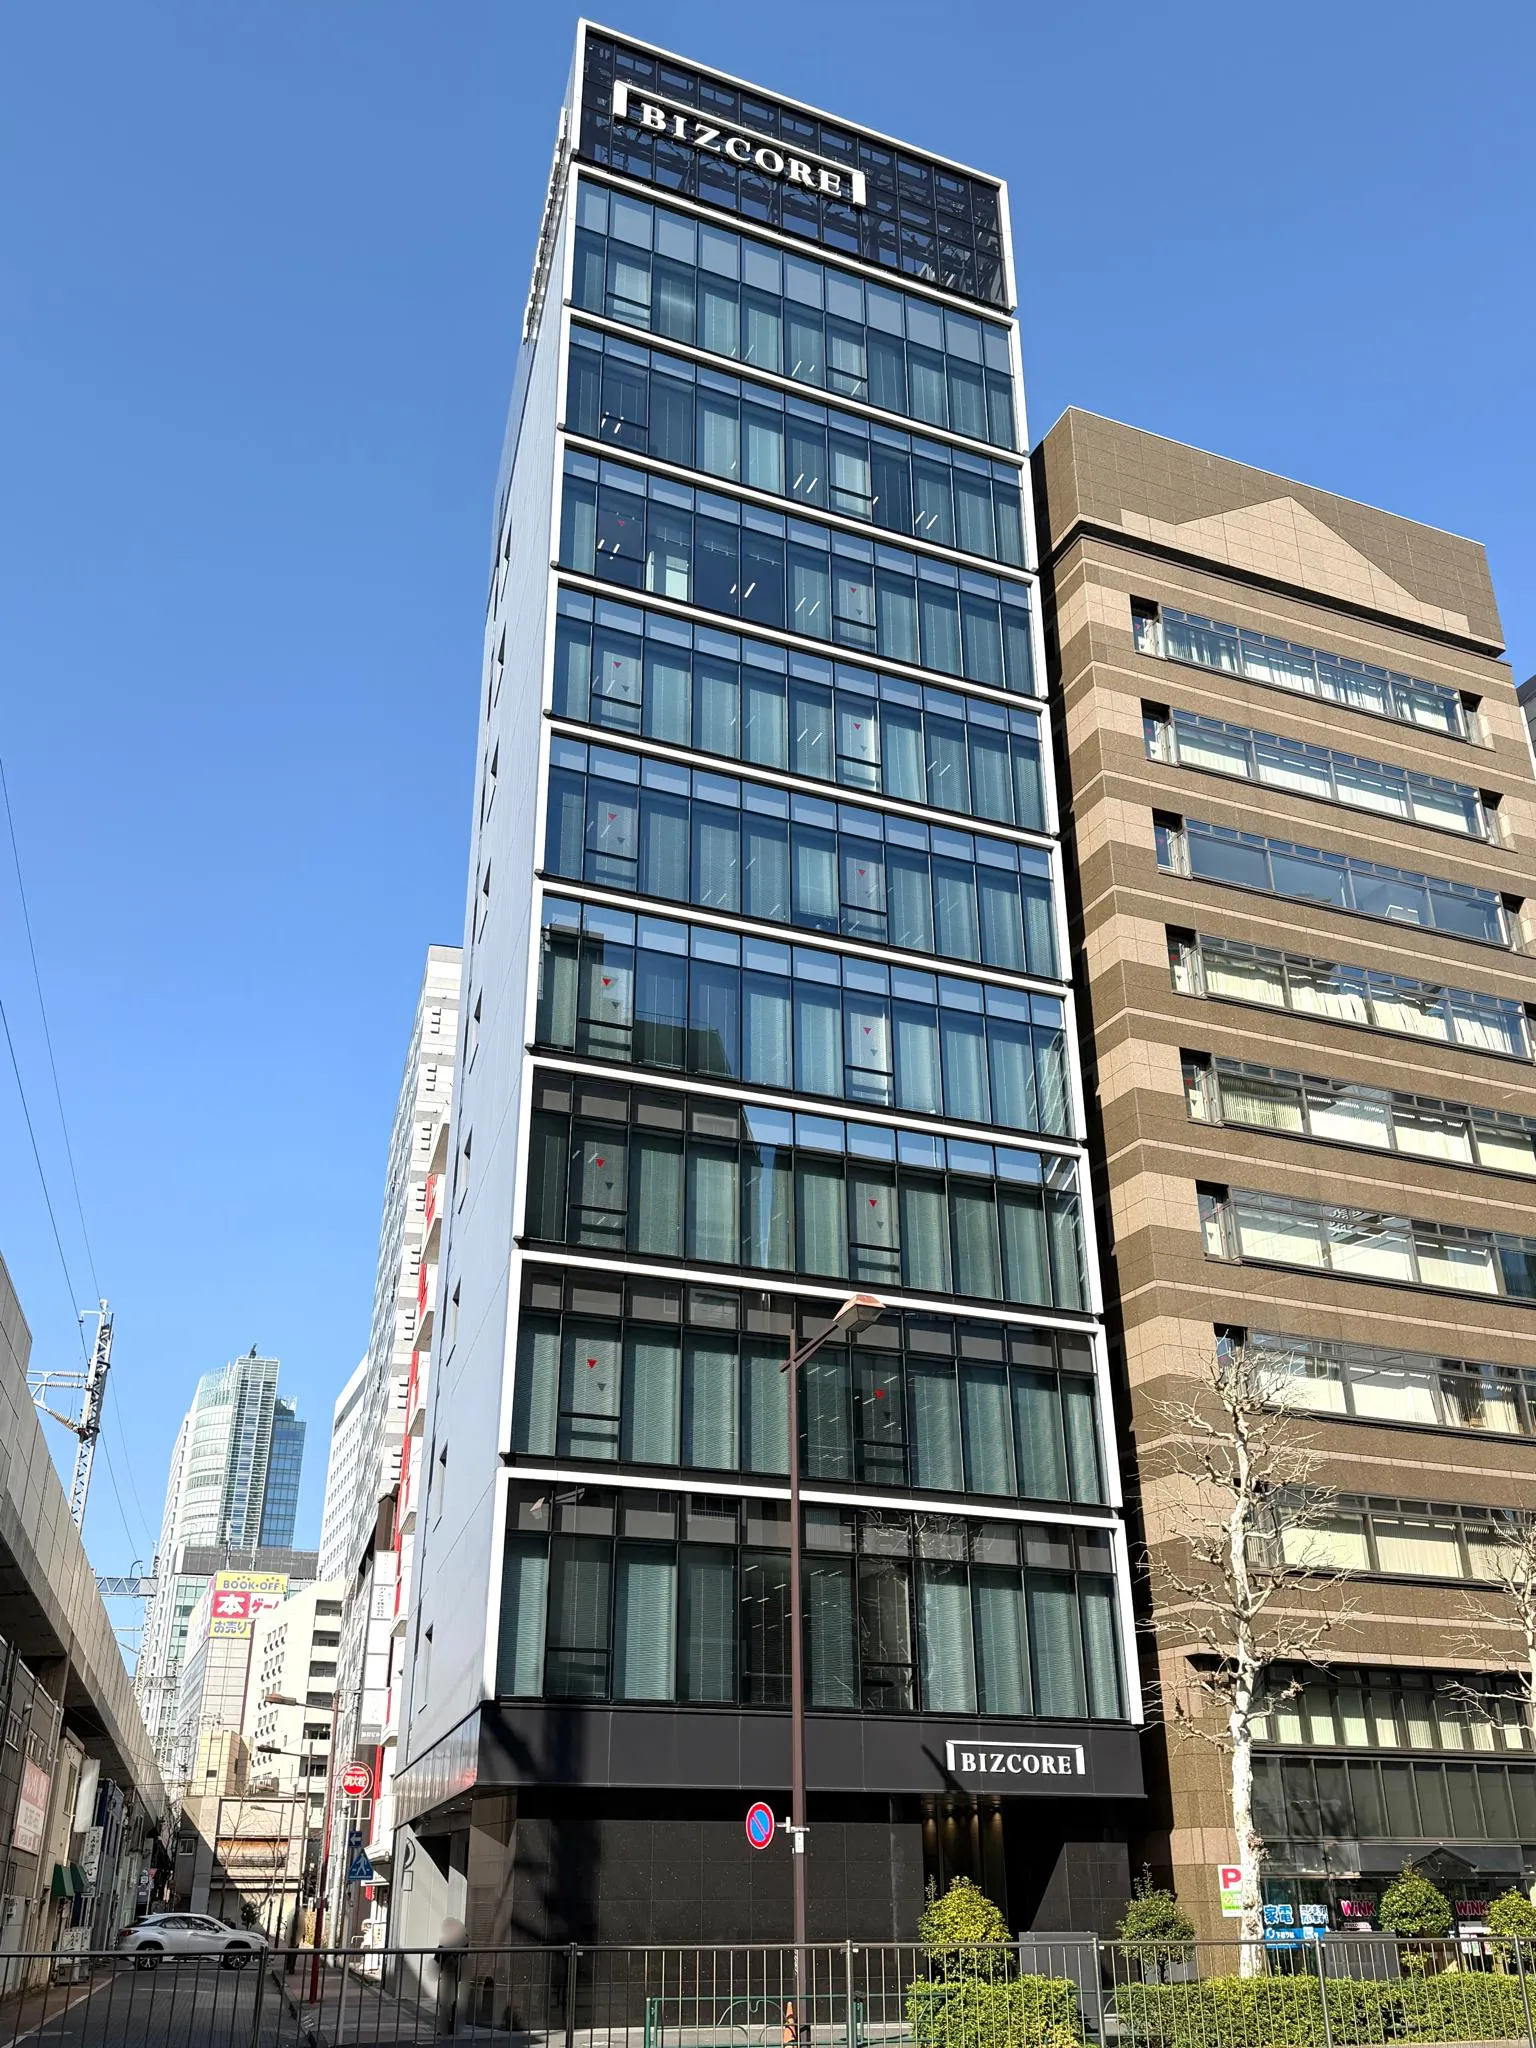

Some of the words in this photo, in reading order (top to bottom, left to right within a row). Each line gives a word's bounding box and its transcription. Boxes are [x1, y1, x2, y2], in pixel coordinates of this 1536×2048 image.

[640, 102, 842, 198] BIZCORE
[216, 1593, 246, 1616] 本
[960, 1752, 1073, 1775] BIZCORE
[1221, 1868, 1242, 1890] P
[1263, 1904, 1294, 1925] 家電
